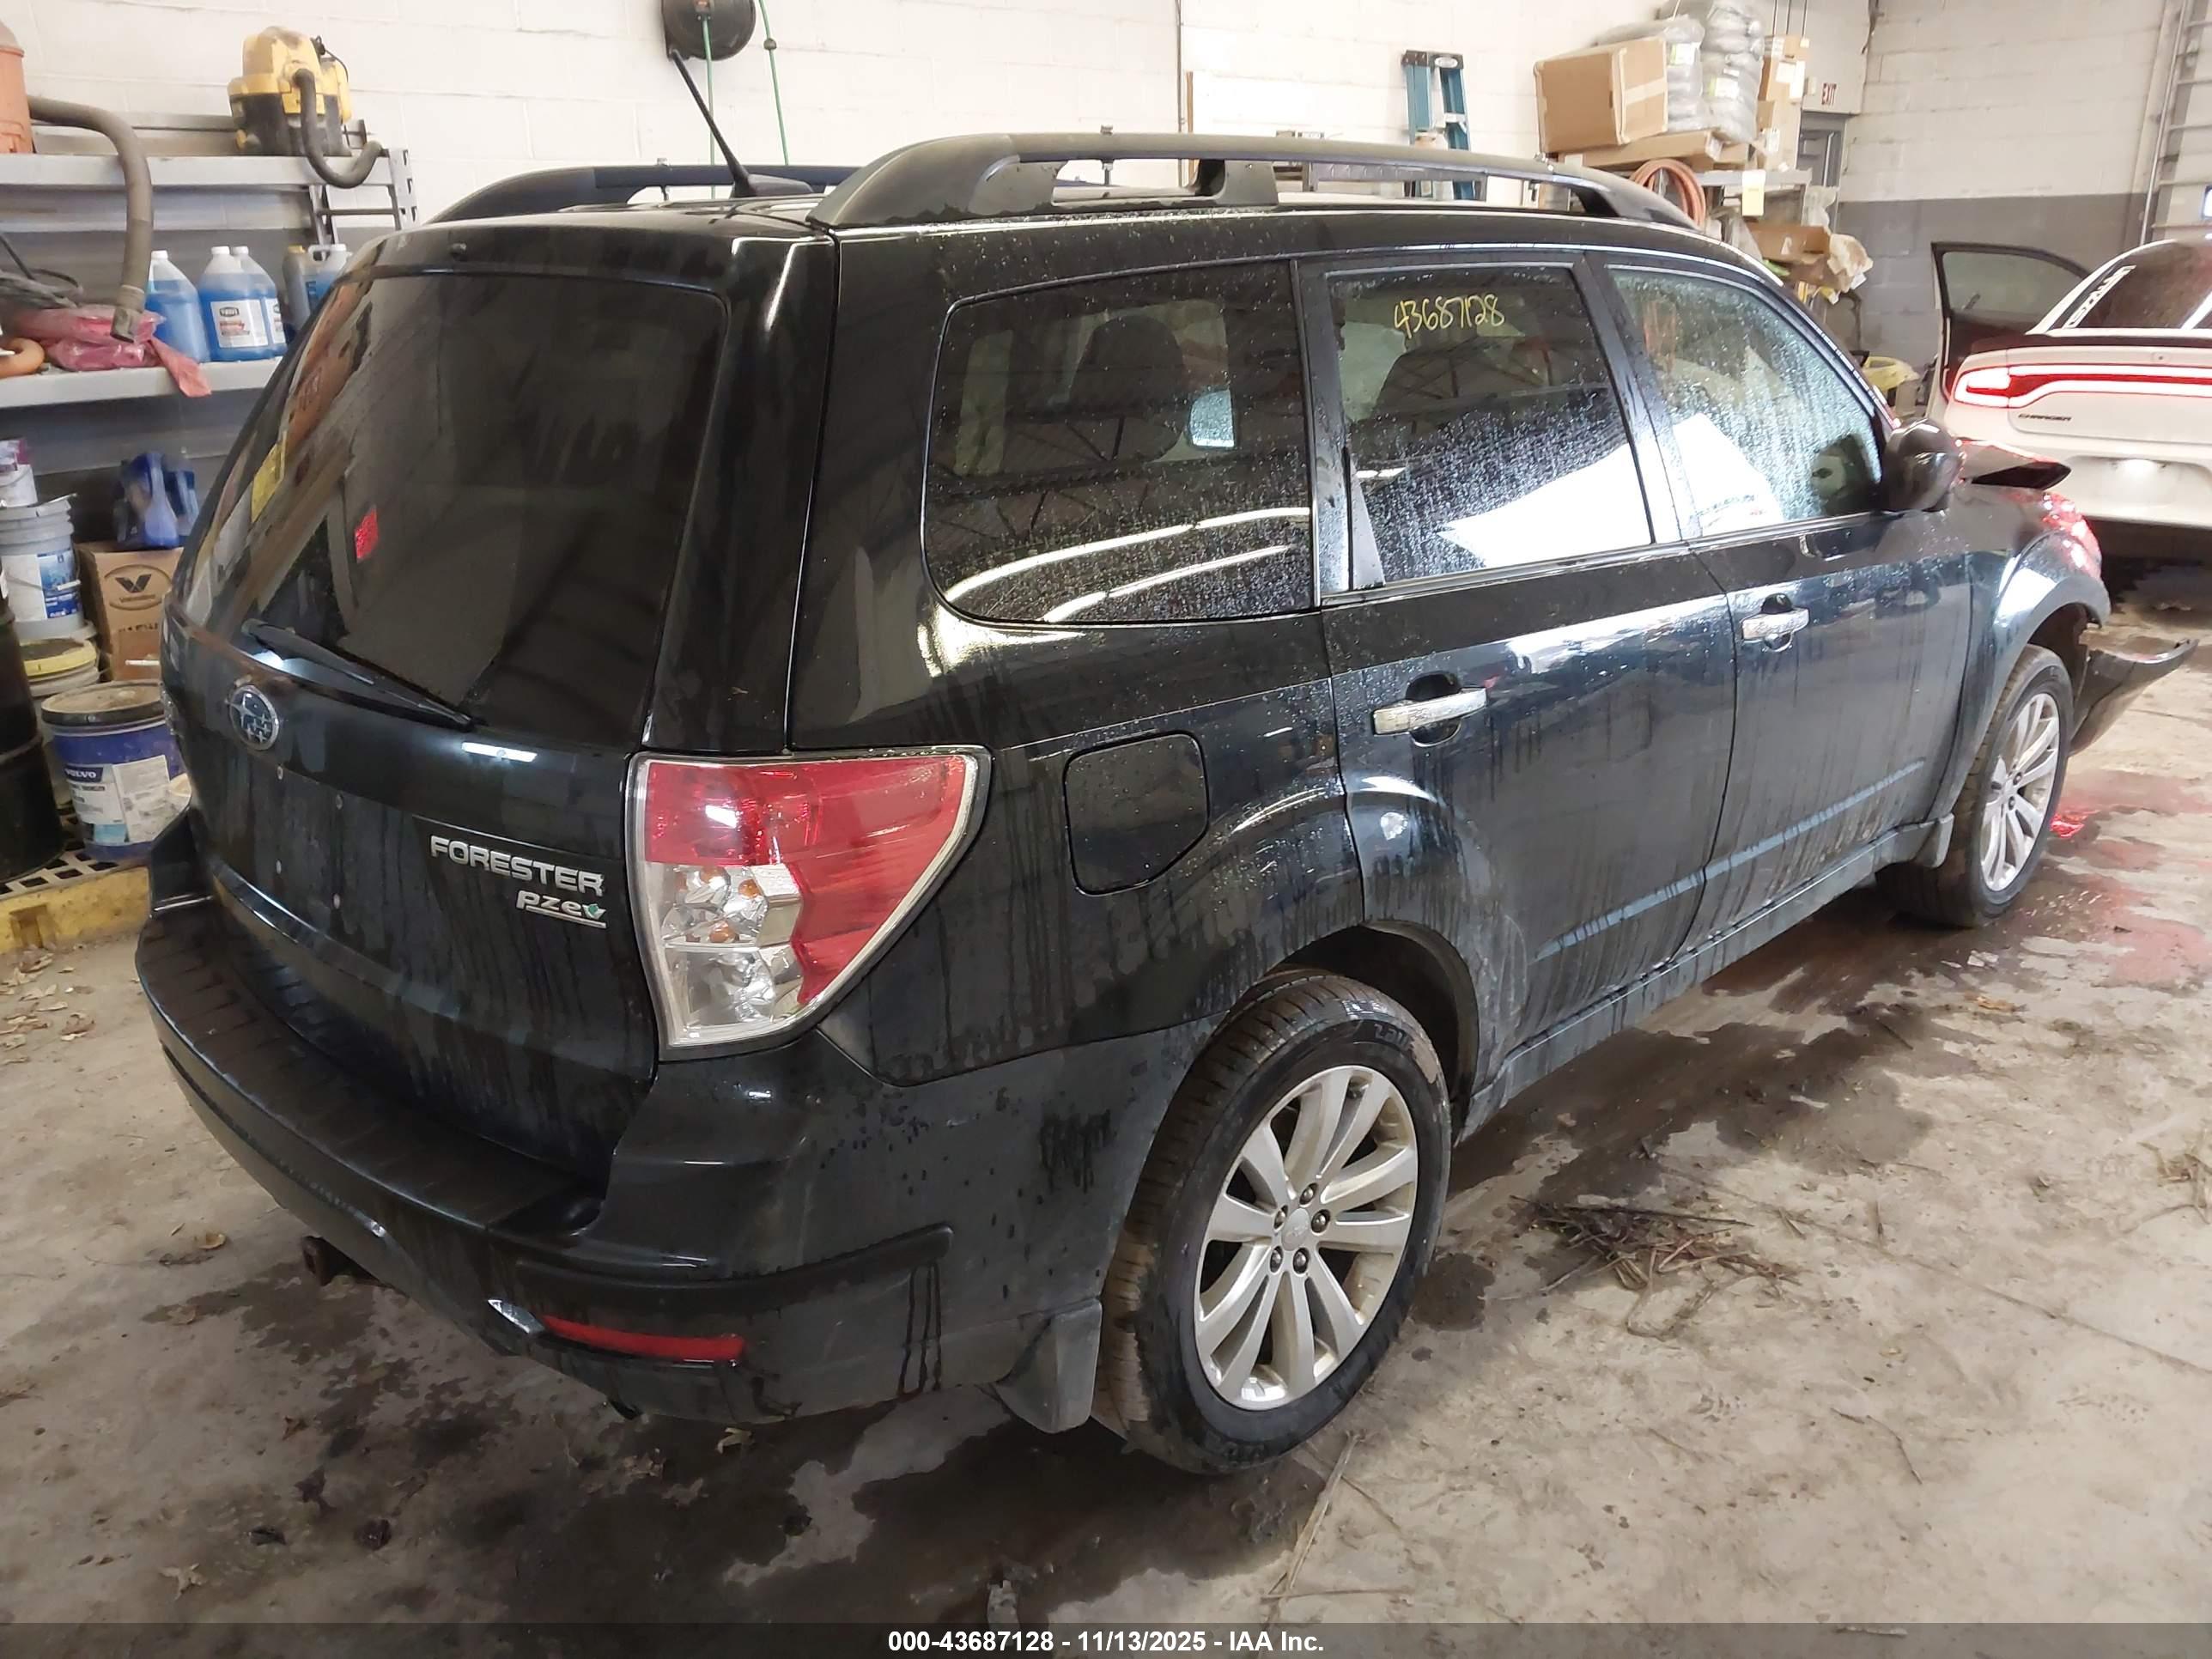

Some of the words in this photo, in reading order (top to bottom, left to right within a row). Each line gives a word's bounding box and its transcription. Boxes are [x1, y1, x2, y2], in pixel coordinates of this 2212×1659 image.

[1821, 82, 1837, 105] EXIT
[1394, 295, 1504, 339] 43687128
[430, 835, 605, 896] FORESTER
